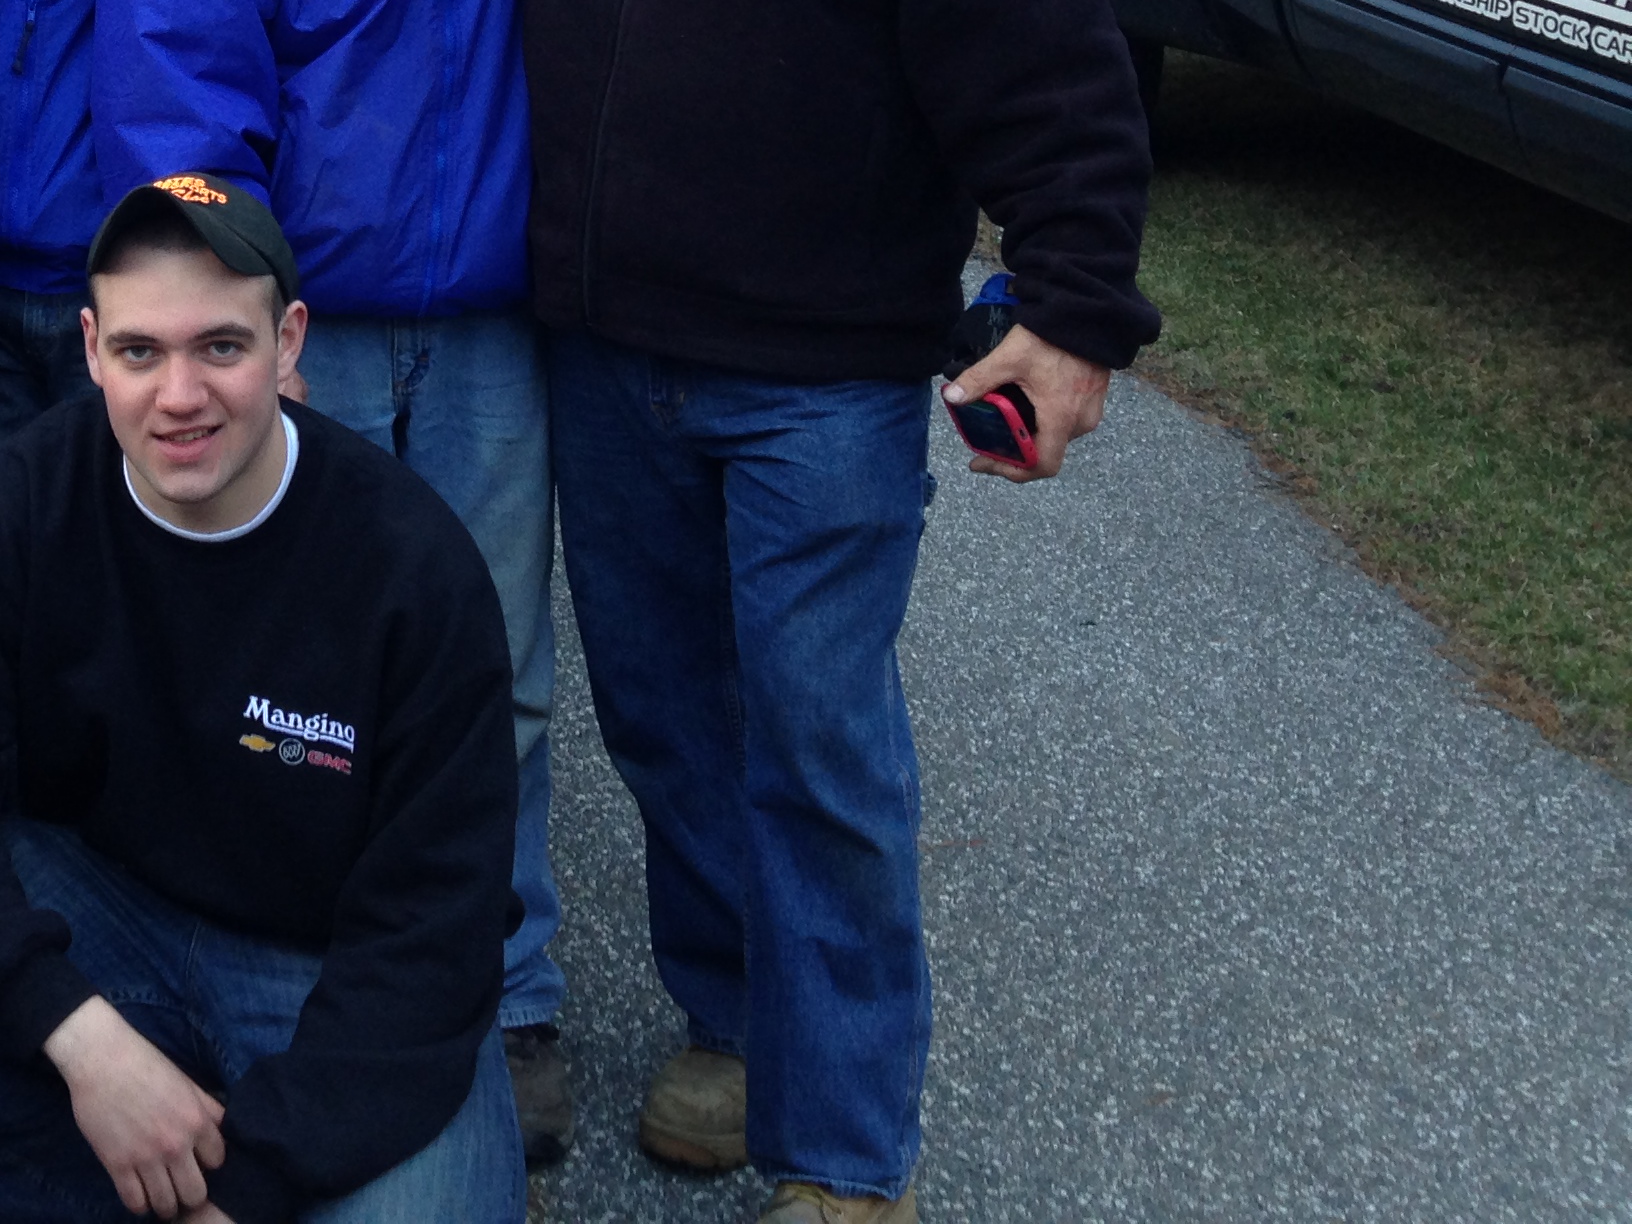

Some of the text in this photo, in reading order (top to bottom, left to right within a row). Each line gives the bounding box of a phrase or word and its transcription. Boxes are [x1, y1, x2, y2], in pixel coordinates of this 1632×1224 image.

[1515, 4, 1588, 45] STOCK
[243, 695, 355, 748] Mangino
[307, 749, 353, 775] GMC
